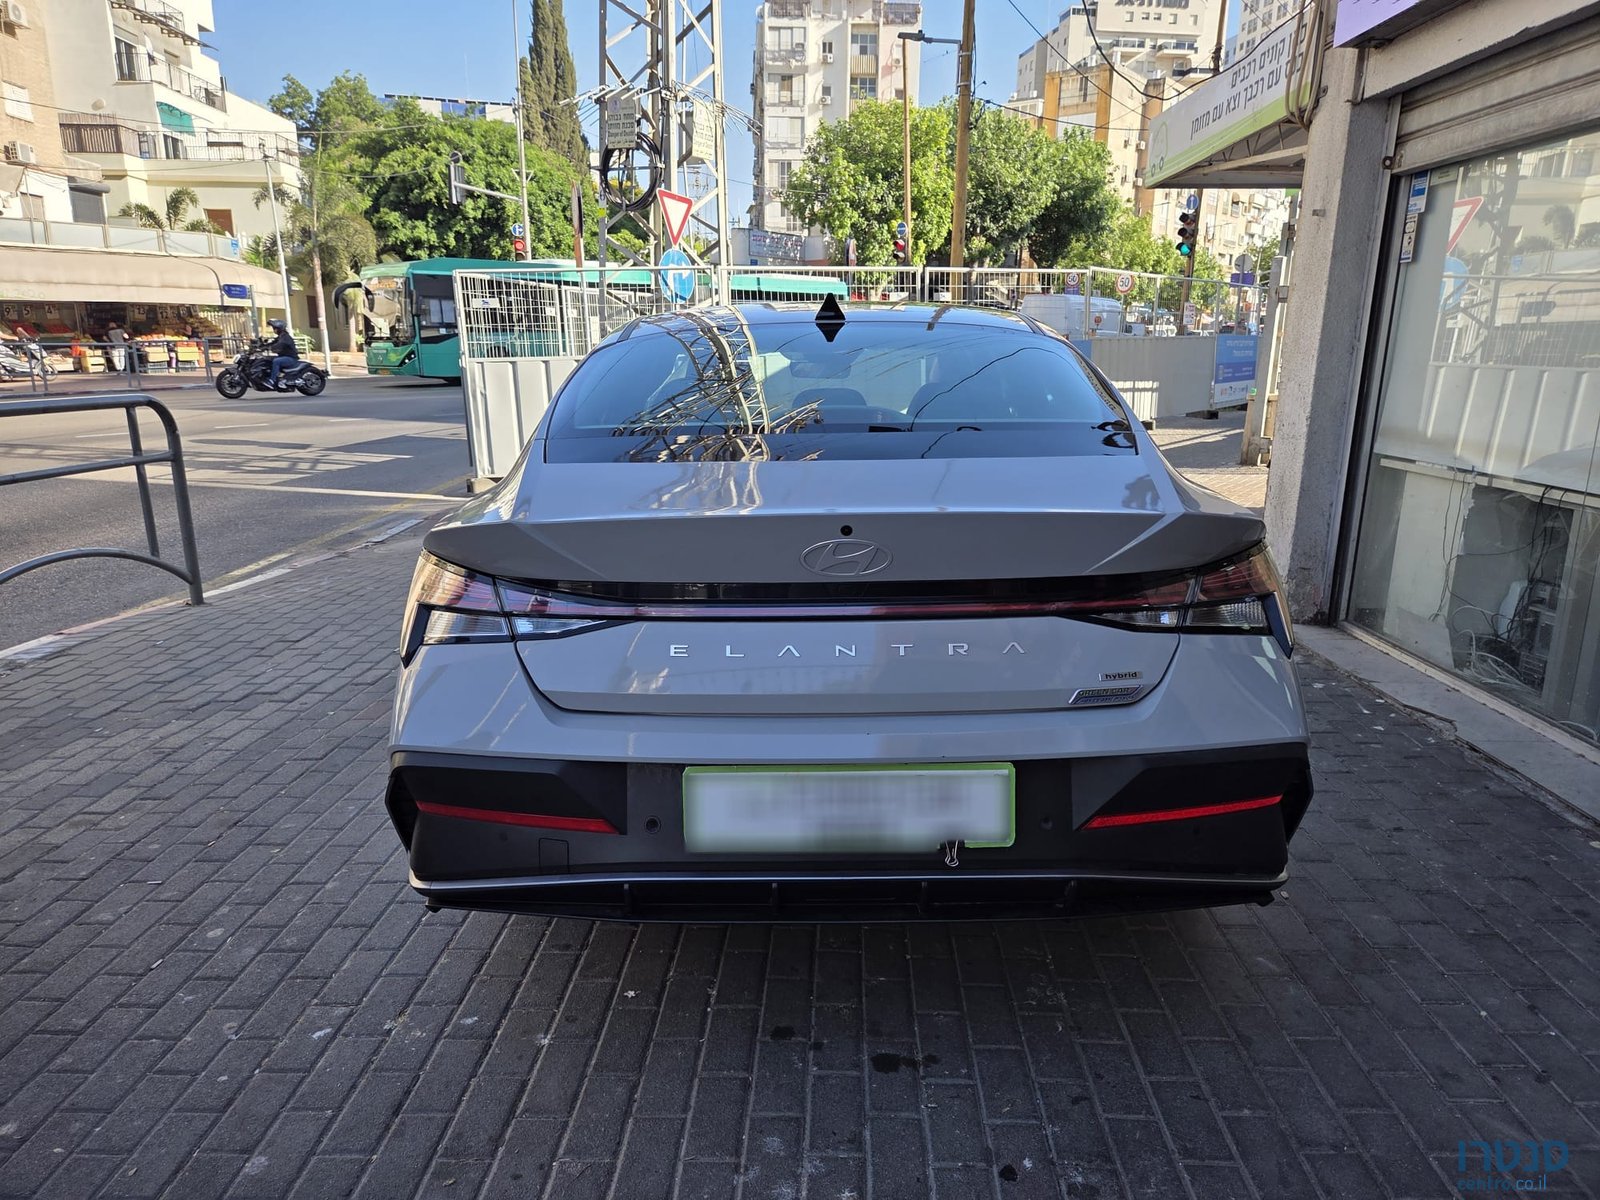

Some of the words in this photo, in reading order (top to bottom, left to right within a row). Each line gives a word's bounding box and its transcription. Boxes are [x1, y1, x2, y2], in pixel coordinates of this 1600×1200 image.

[1287, 23, 1307, 59] כן
[1259, 38, 1285, 70] קונים
[1231, 59, 1257, 89] רכבים
[1266, 65, 1282, 89] עם
[1225, 91, 1241, 116] וצא
[1243, 77, 1265, 110] רכבך
[1212, 101, 1224, 122] עם
[1190, 111, 1210, 140] מזומן
[1068, 275, 1077, 283] 50
[1119, 277, 1130, 287] 50
[669, 643, 1025, 658] ELANTRA
[1105, 671, 1137, 680] hybrid
